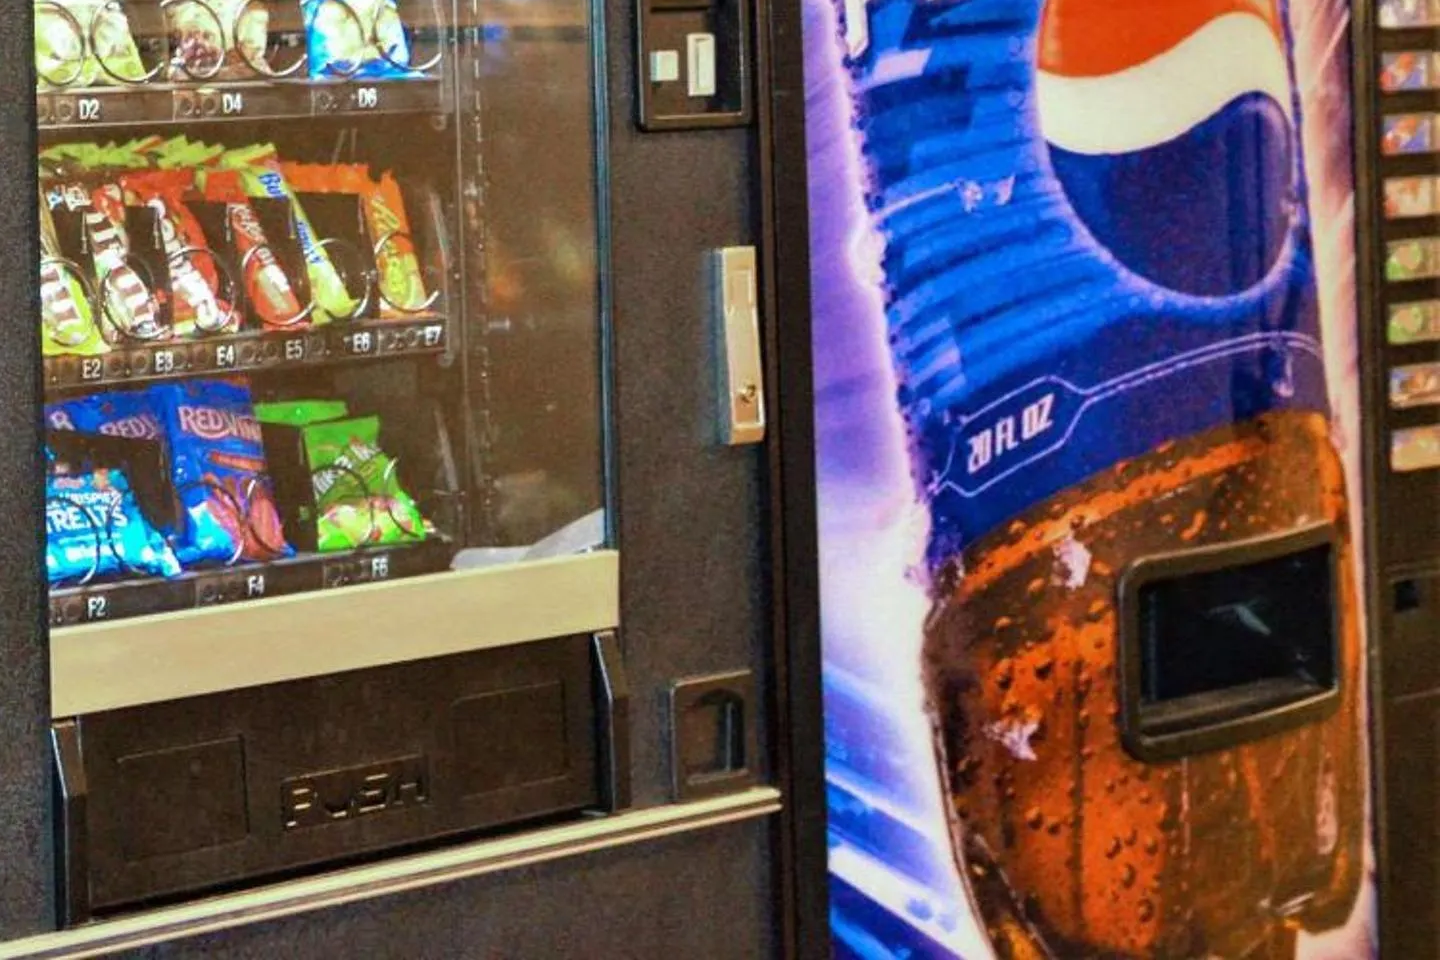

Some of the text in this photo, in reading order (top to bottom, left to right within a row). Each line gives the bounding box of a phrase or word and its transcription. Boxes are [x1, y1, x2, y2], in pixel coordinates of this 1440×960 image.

[78, 98, 100, 120] D2
[222, 93, 243, 115] D4
[358, 88, 378, 109] D6
[216, 344, 235, 367] E4
[284, 339, 304, 361] E5
[81, 358, 102, 380] E2
[154, 350, 174, 373] E3
[967, 391, 1055, 475] 20 FL OZ
[248, 574, 266, 596] F4
[87, 596, 107, 618] F2
